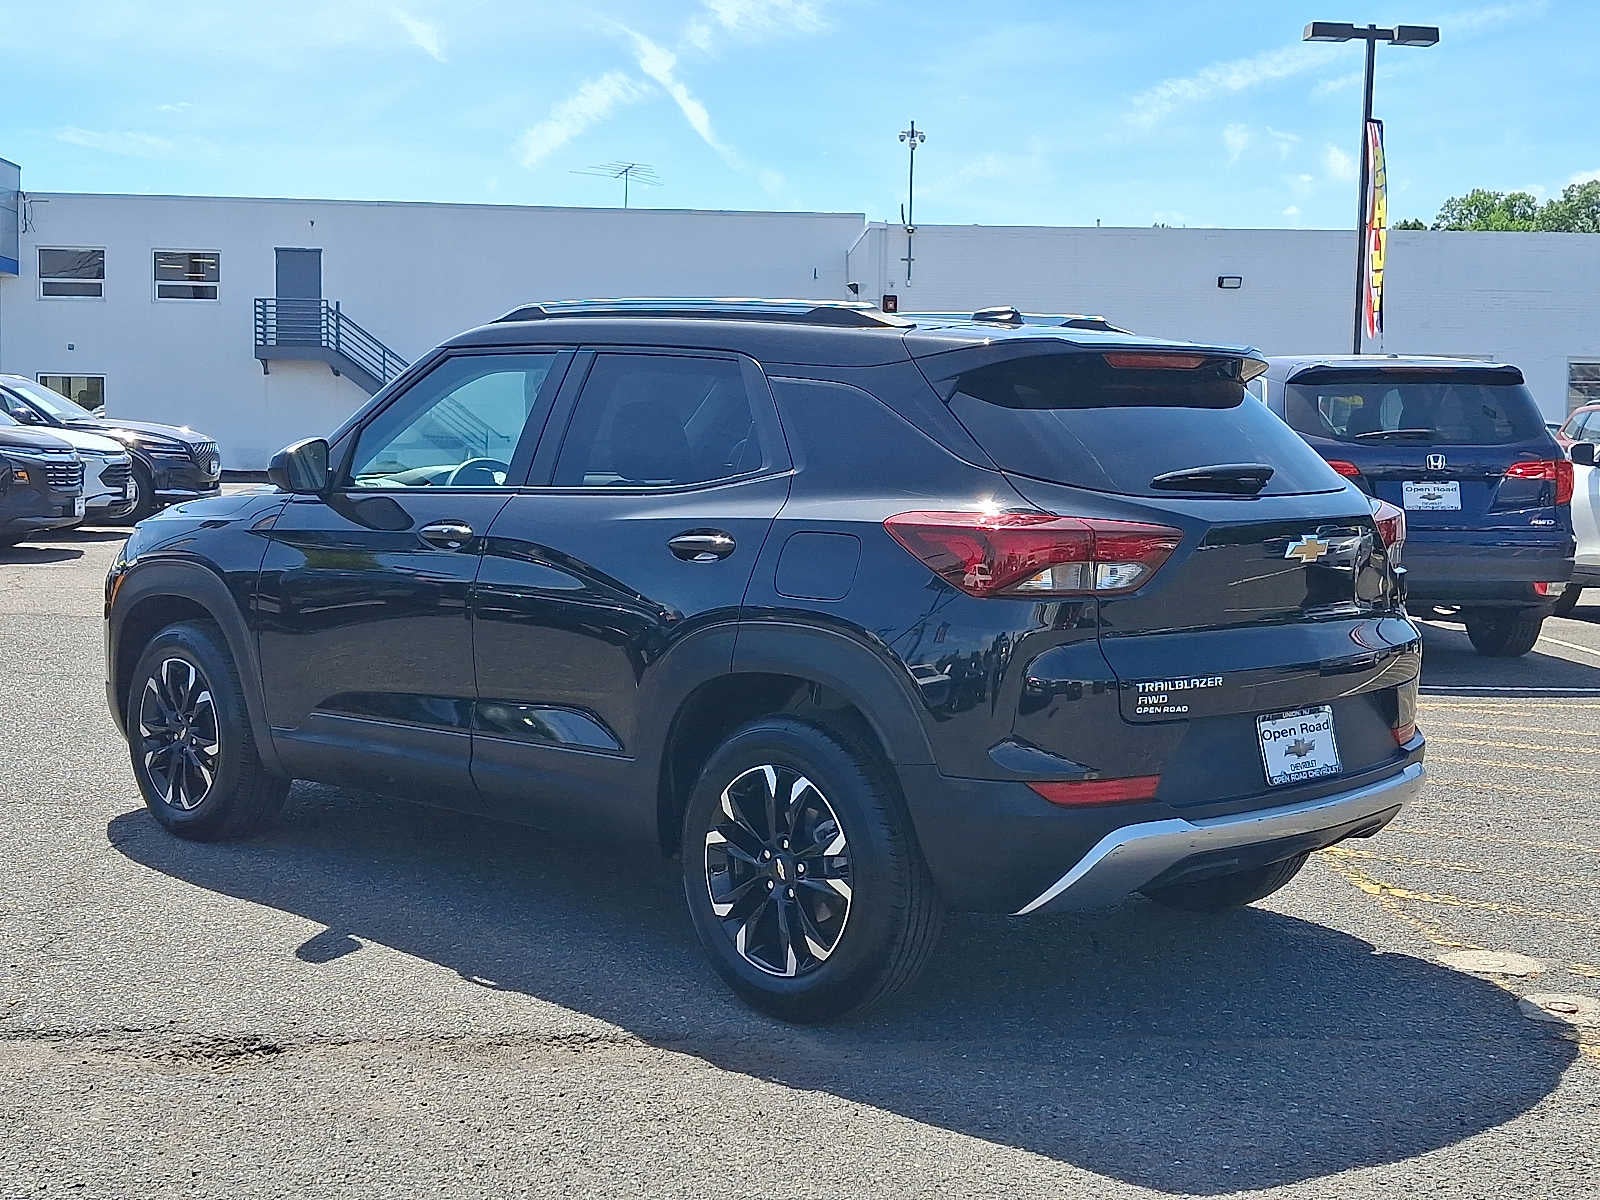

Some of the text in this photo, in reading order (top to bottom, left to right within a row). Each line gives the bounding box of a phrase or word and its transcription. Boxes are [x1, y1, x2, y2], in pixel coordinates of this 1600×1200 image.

[1136, 676, 1223, 693] TRAILBLAZER
[1138, 694, 1168, 705] AWD
[1136, 705, 1189, 714] OPEN ROAD
[1262, 719, 1330, 743] Open Road
[1272, 773, 1291, 785] OPEN
[1290, 770, 1308, 782] ROAD
